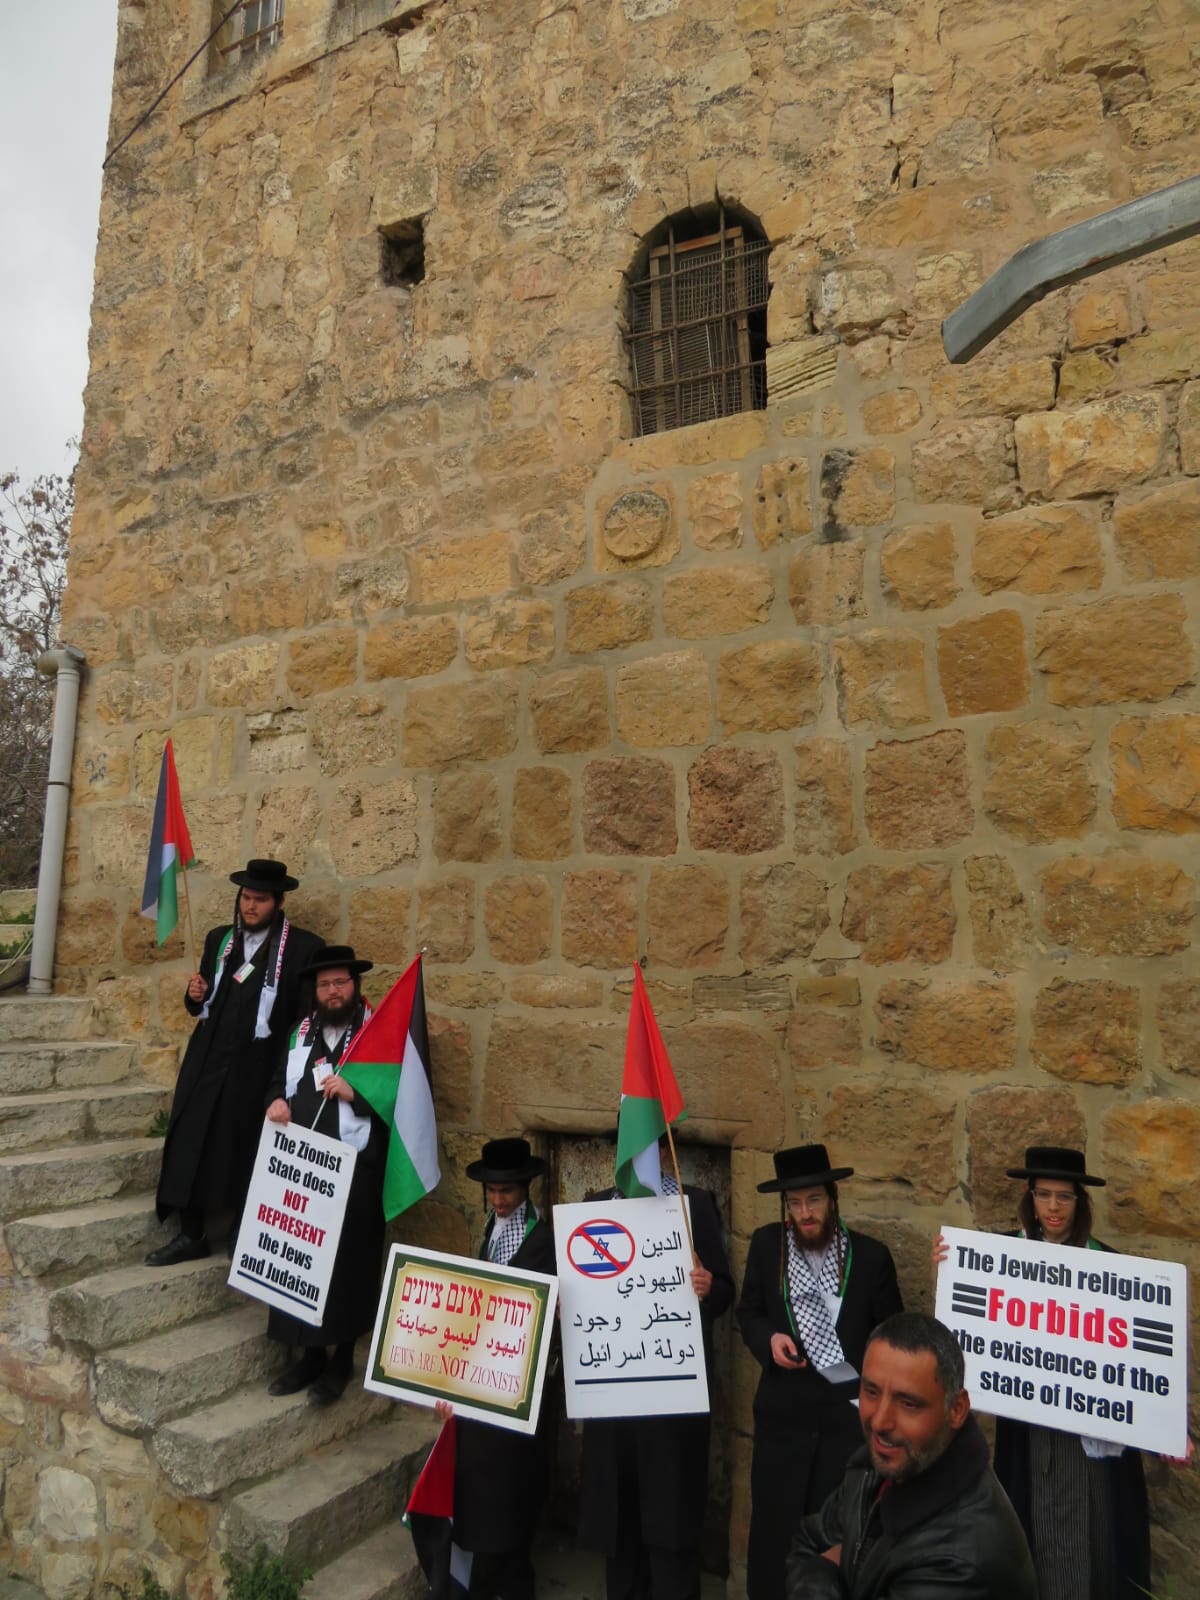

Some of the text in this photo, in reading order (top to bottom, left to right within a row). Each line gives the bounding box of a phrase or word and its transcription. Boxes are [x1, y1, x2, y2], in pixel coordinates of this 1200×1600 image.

[273, 1130, 342, 1173] The Zionist
[268, 1156, 335, 1198] State does
[282, 1188, 309, 1214] NOT
[257, 1203, 326, 1248] REPRESENT
[641, 1230, 682, 1258] الدين
[258, 1231, 313, 1271] the Jews
[240, 1252, 320, 1302] and Judaism
[617, 1267, 685, 1299] اليهودي
[956, 1246, 1172, 1306] The Jewish religion
[396, 1308, 438, 1336] صهاينة
[401, 1275, 532, 1328] יהודים אינם ציונים
[573, 1302, 692, 1333] يحظر وجود
[988, 1288, 1128, 1350] Forbids
[438, 1323, 480, 1352] ليسو
[579, 1338, 695, 1368] دولة اسرائيل
[388, 1344, 521, 1394] JEWS ARE NOT ZIONISTS
[990, 1336, 1097, 1381] existence
[1102, 1362, 1126, 1387] of
[1130, 1367, 1170, 1397] the
[980, 1370, 1134, 1424] state of Israel
